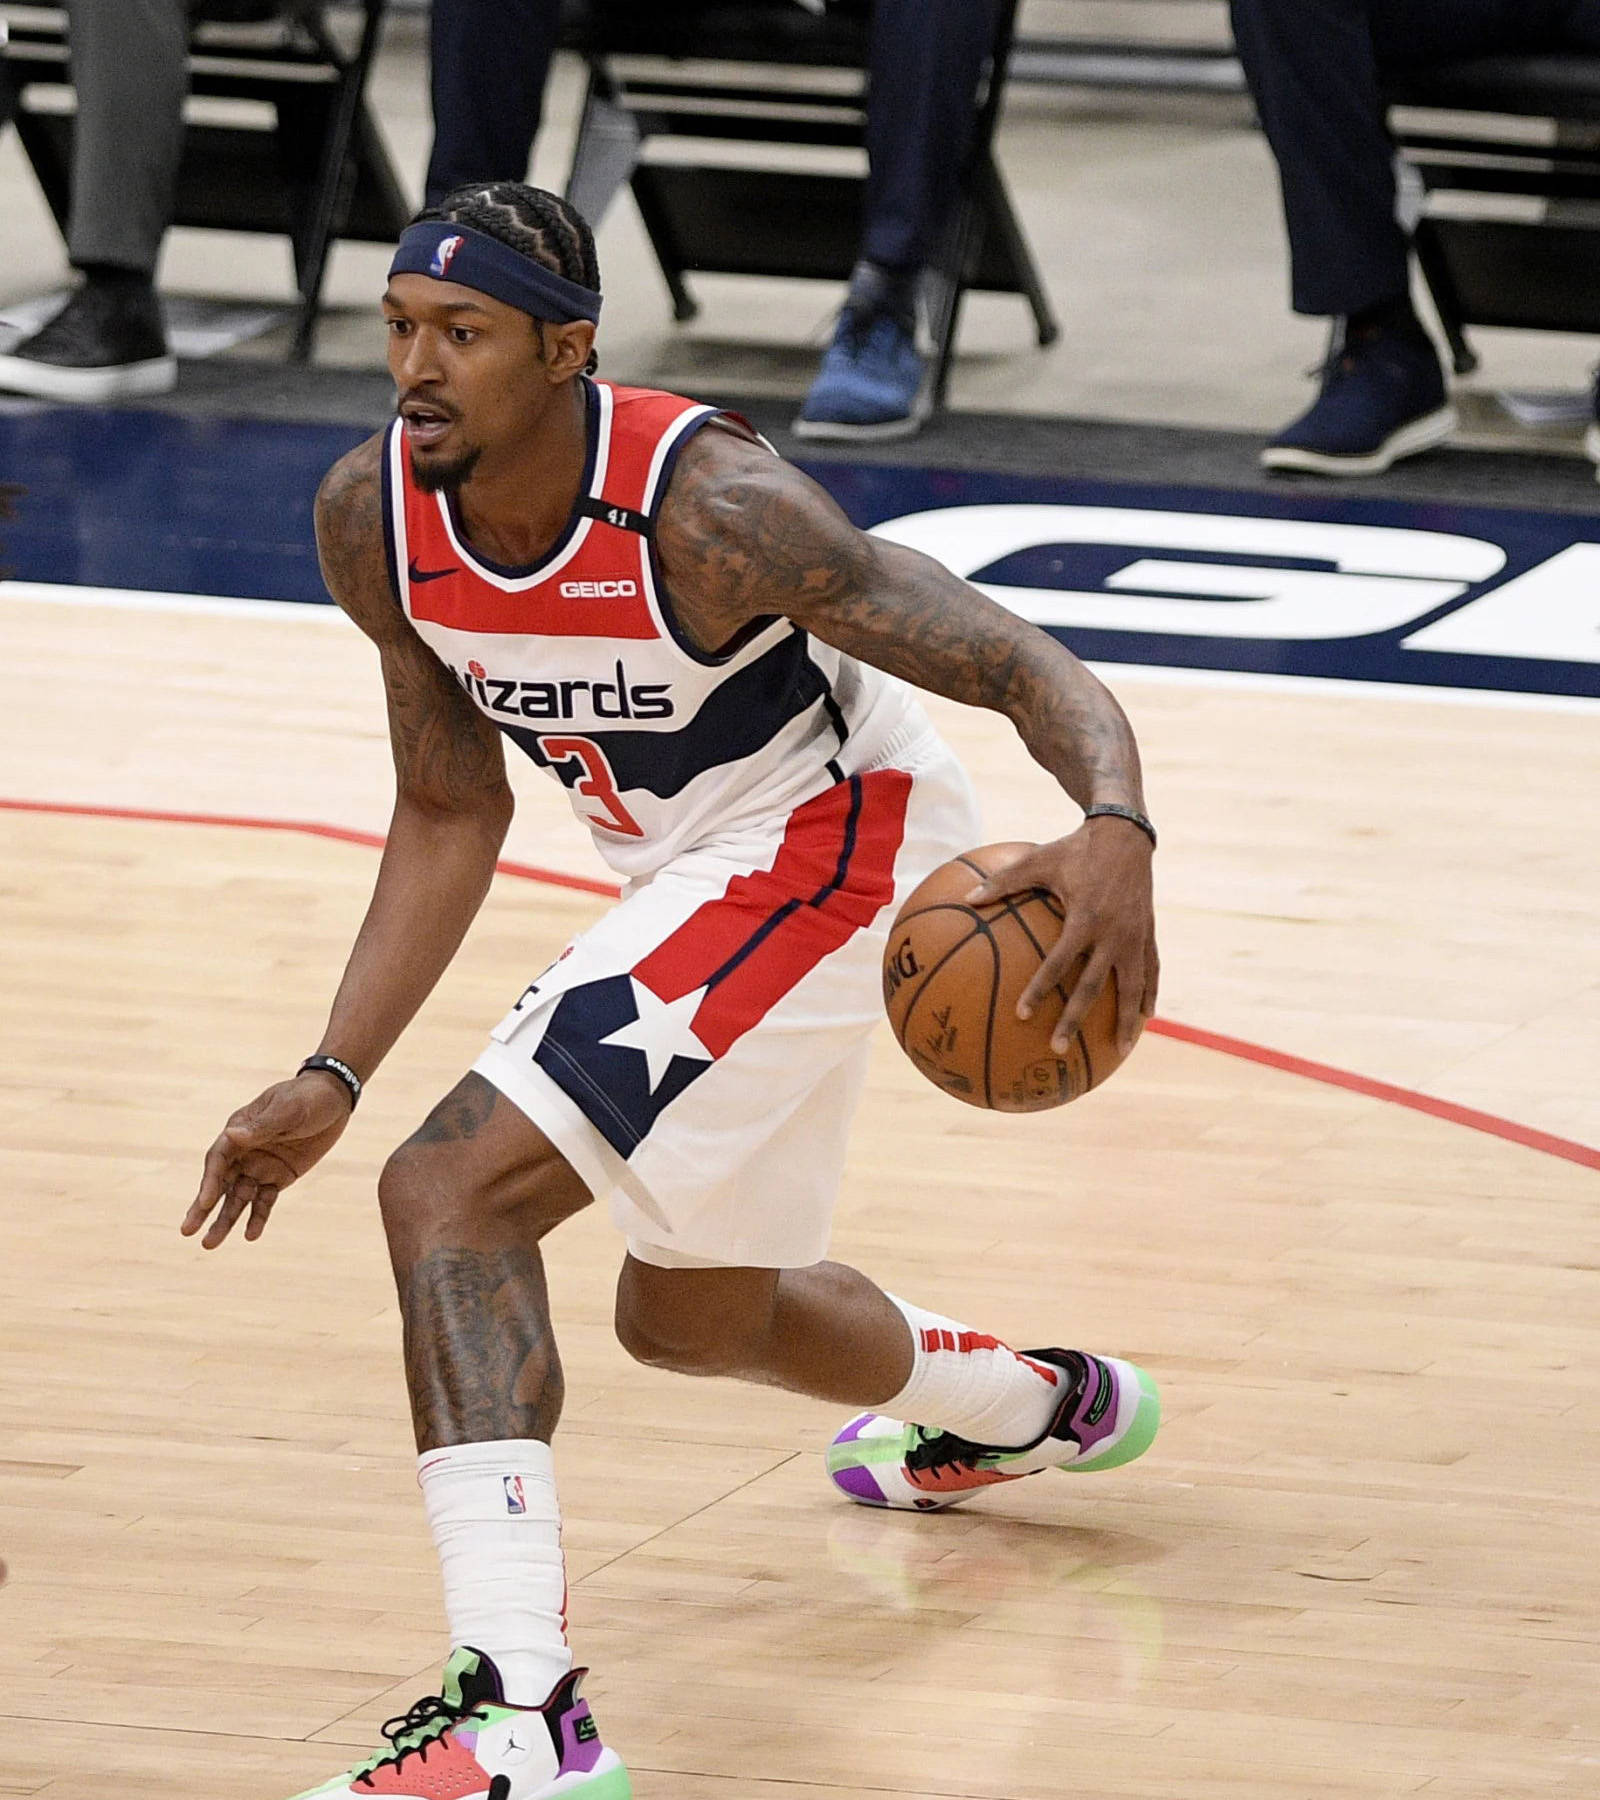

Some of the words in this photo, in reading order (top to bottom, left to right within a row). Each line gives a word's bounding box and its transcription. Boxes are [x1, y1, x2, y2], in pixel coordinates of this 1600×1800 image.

[606, 508, 628, 527] 41
[560, 579, 638, 599] GEICO
[537, 735, 645, 837] 3
